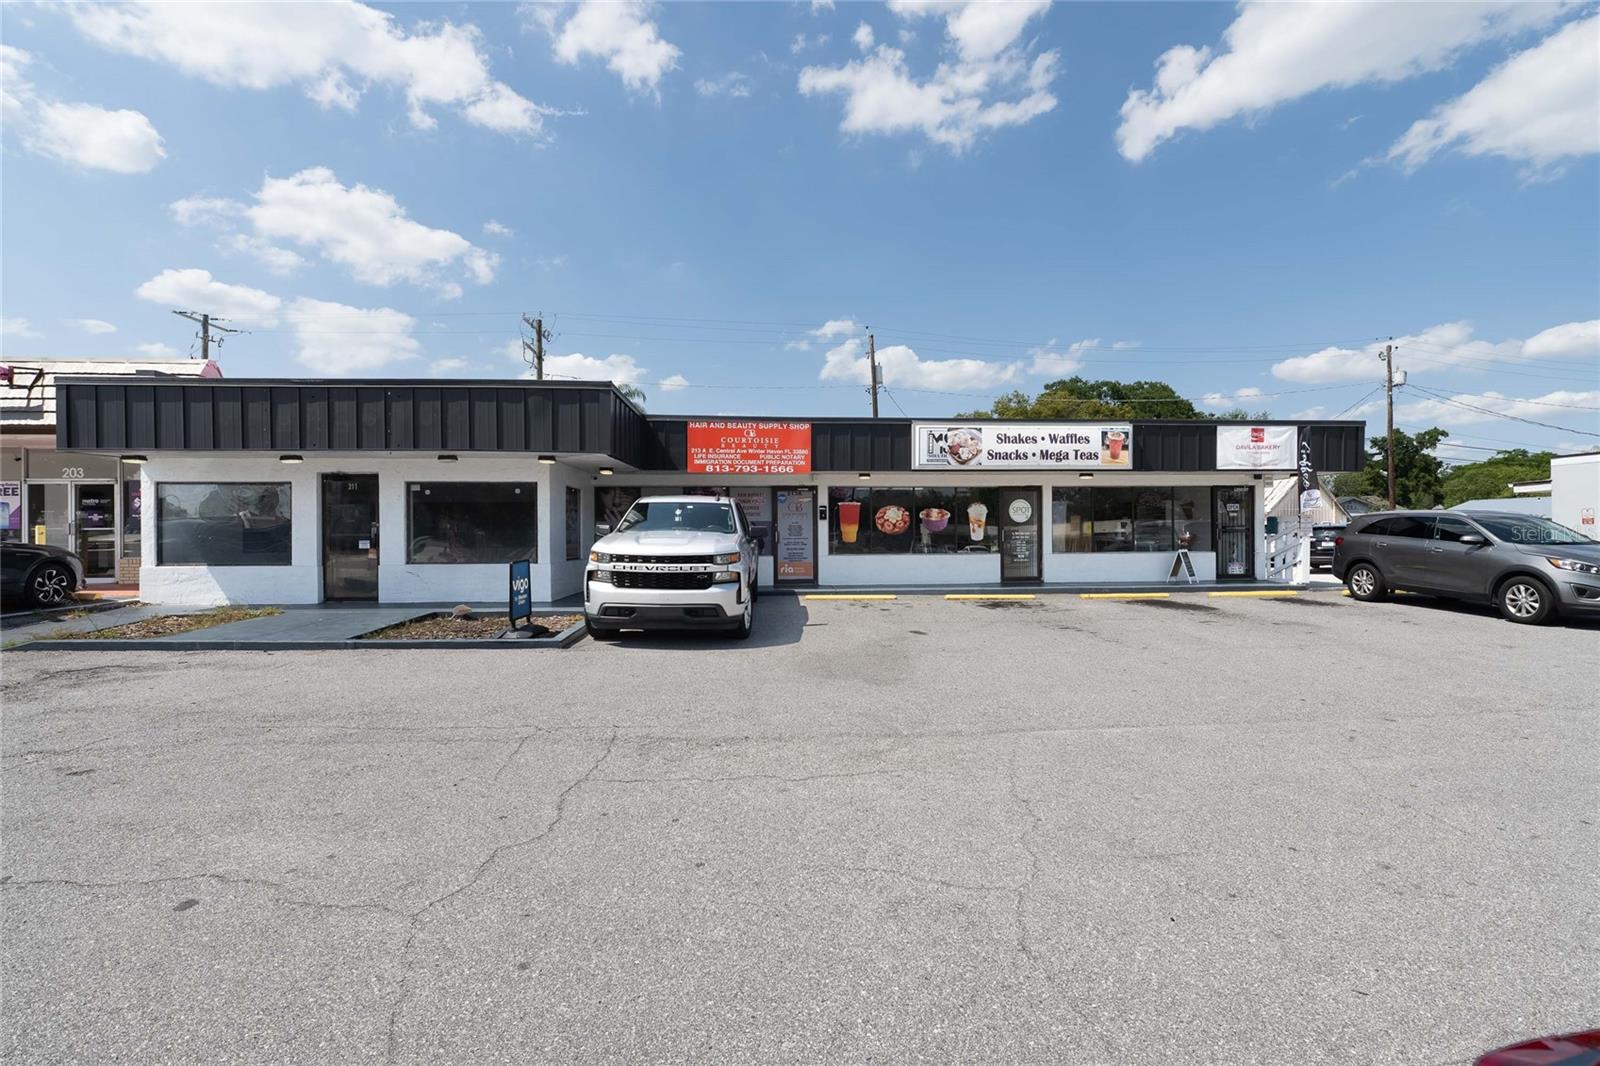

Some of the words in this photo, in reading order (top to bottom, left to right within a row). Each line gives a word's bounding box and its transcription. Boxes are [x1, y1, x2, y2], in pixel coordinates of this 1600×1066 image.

[720, 436, 780, 444] COURTOISIE
[996, 433, 1038, 444] Shakes
[1048, 433, 1090, 444] Waffles
[986, 449, 1029, 460] Snacks
[1039, 449, 1069, 463] Mega
[1072, 449, 1099, 460] Teas
[62, 467, 84, 478] 203
[705, 465, 794, 473] 813-793-1566
[512, 576, 529, 593] vigo
